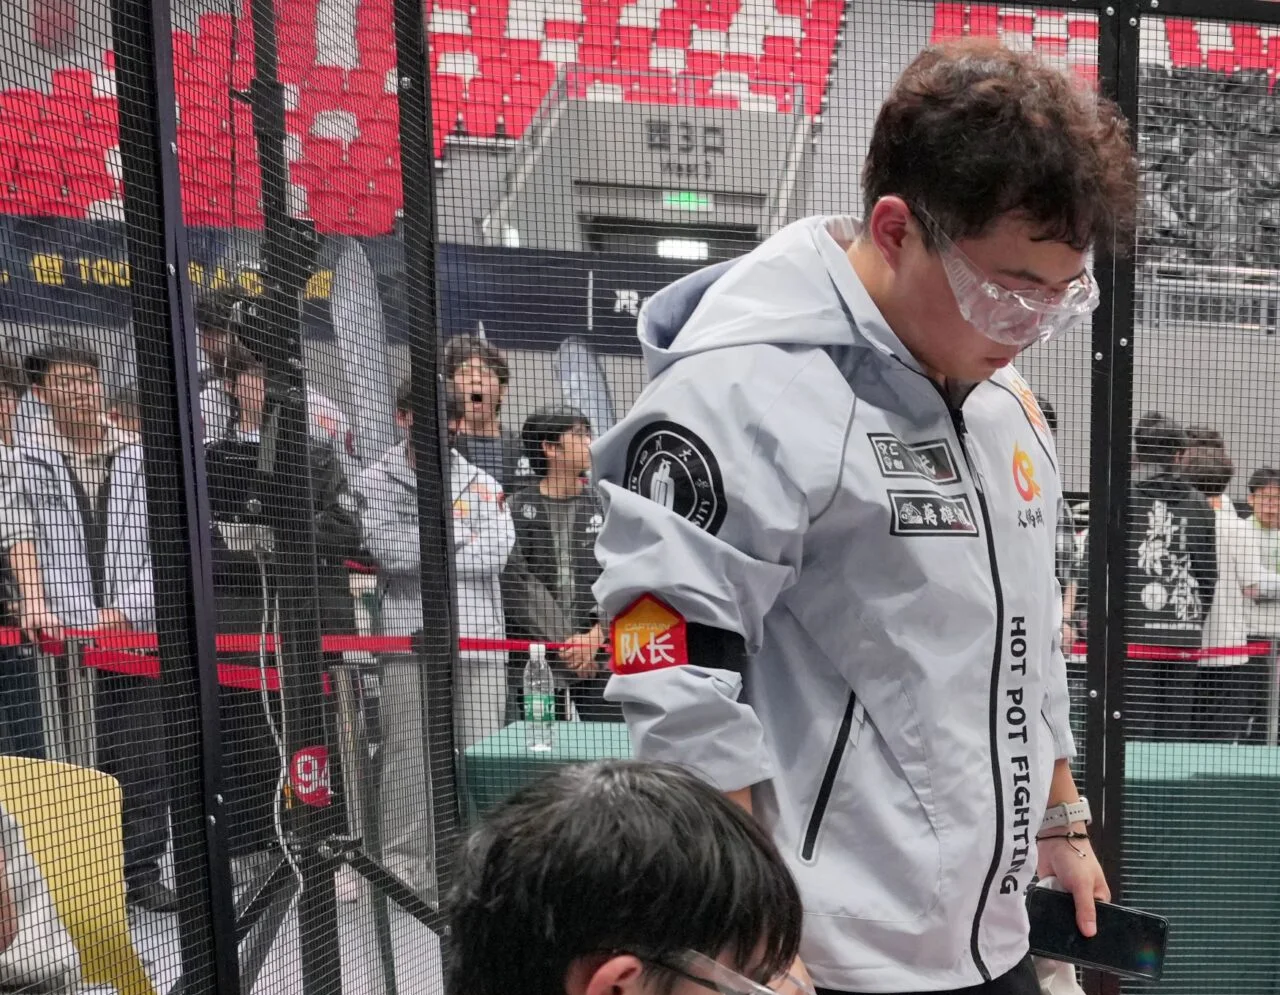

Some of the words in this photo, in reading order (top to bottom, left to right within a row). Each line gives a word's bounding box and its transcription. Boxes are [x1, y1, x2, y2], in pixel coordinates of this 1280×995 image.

[620, 631, 676, 665] 队长
[1010, 615, 1027, 676] HOT
[1006, 687, 1028, 744] POT
[1000, 755, 1031, 895] FIGHTING
